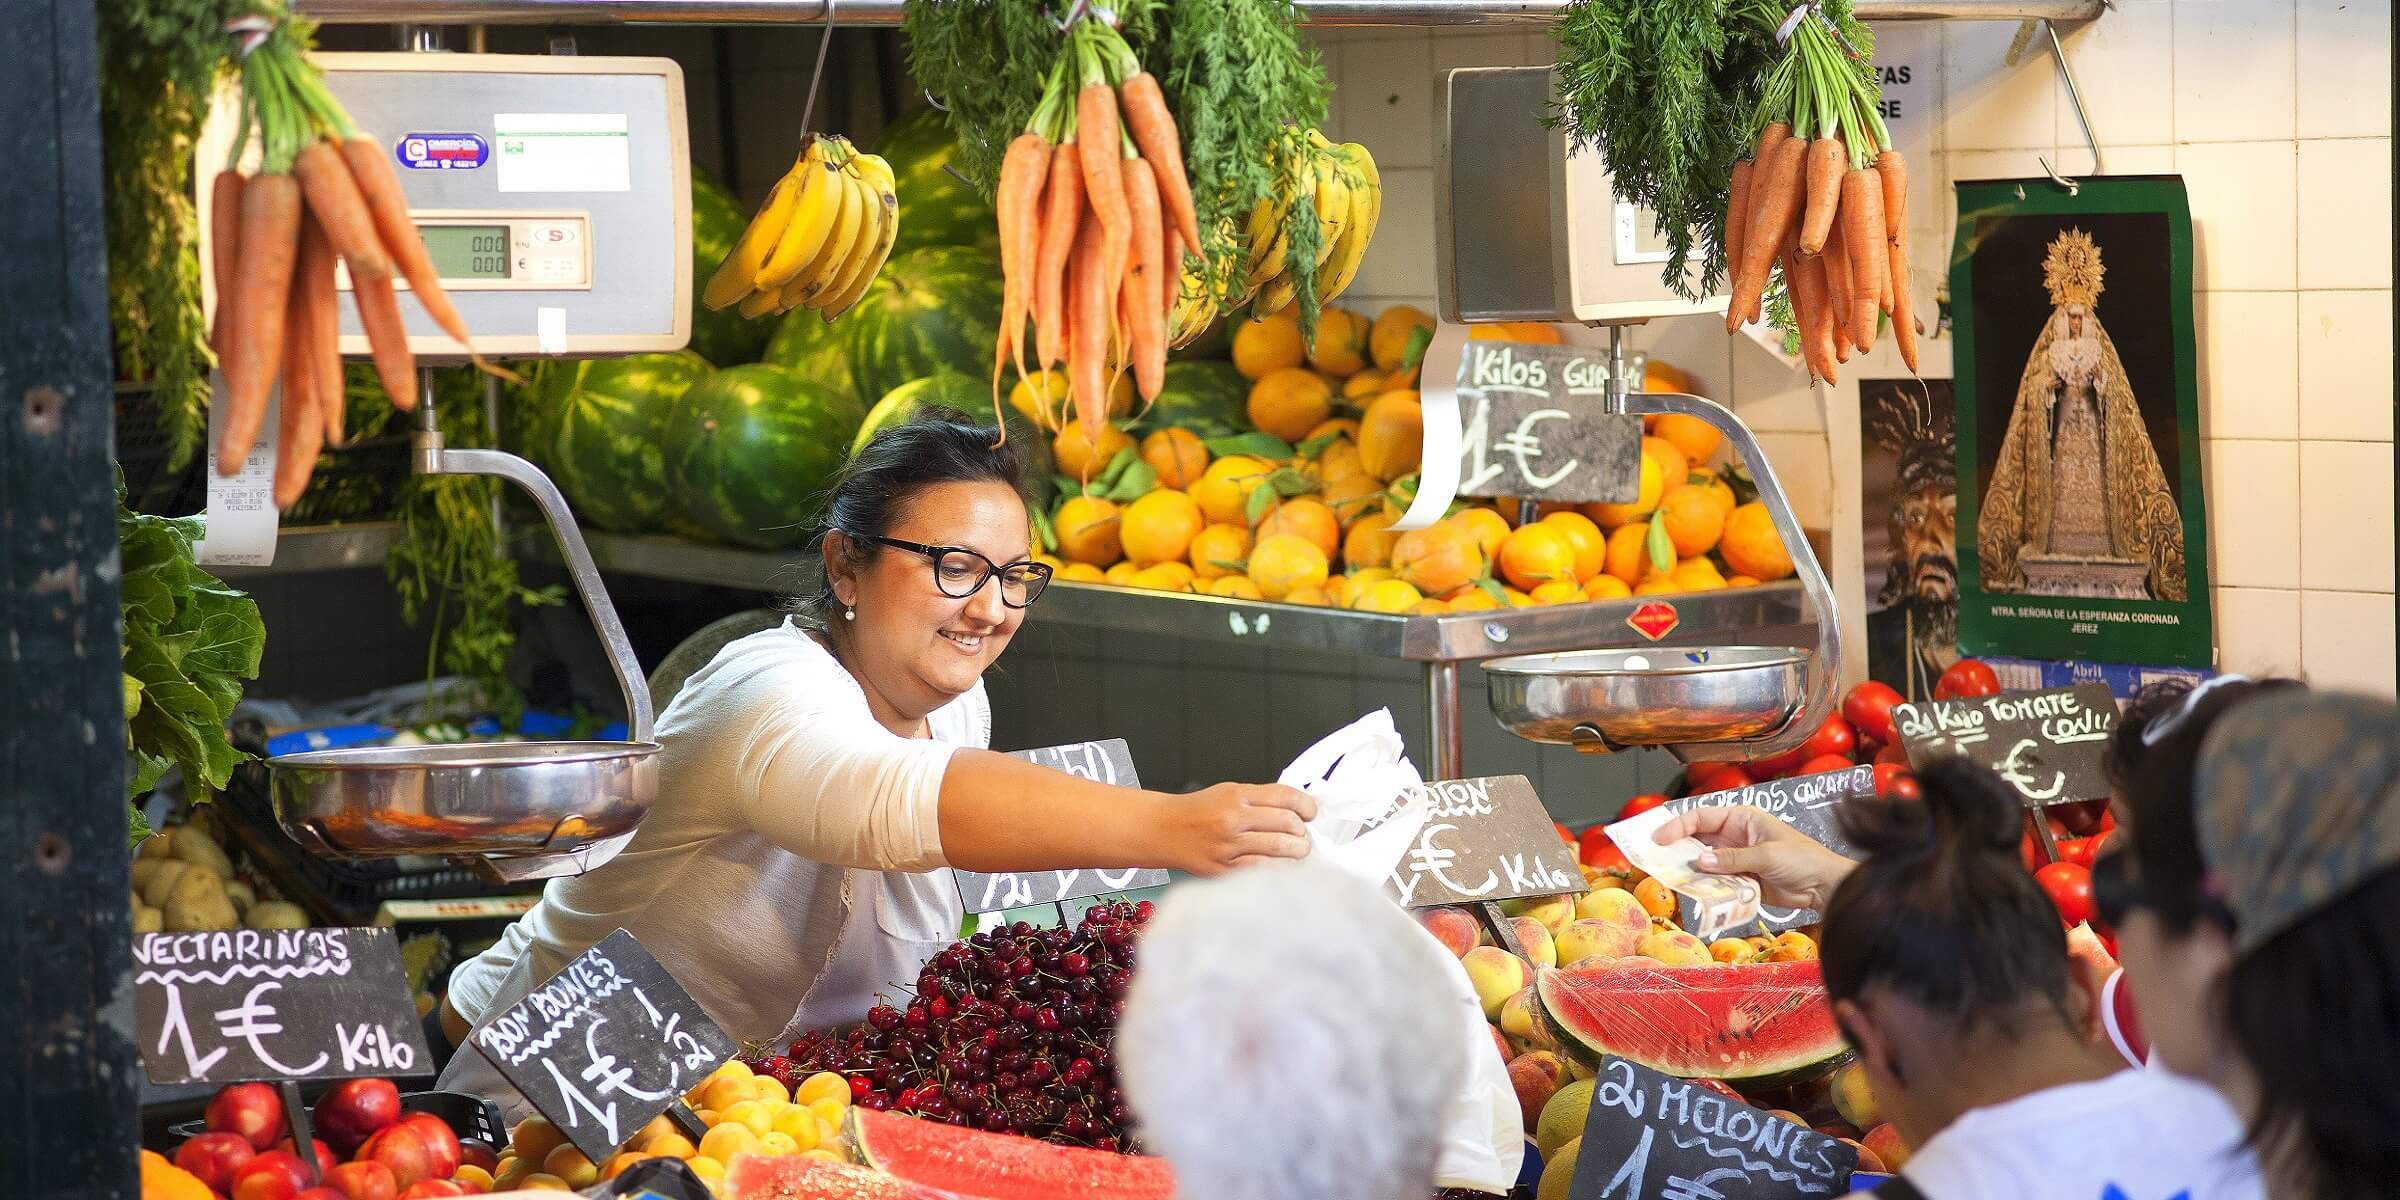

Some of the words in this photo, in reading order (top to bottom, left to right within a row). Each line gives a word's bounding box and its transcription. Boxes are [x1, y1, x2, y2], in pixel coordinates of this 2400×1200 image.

[1473, 346, 1547, 387] Kilos
[1991, 606, 2016, 618] NTRA.
[2018, 606, 2053, 620] SEÑORA
[2054, 608, 2066, 620] DE
[2067, 610, 2079, 621] LA
[2079, 610, 2130, 623] ESPERANZA
[2131, 612, 2180, 626] CORONADA
[2071, 623, 2099, 635] JEREZ
[2073, 664, 2102, 678] Abril
[1984, 692, 2080, 722] TOMATE
[1499, 852, 1572, 894] Kilo
[335, 1022, 414, 1072] Kilo
[1599, 1060, 1645, 1119] 2
